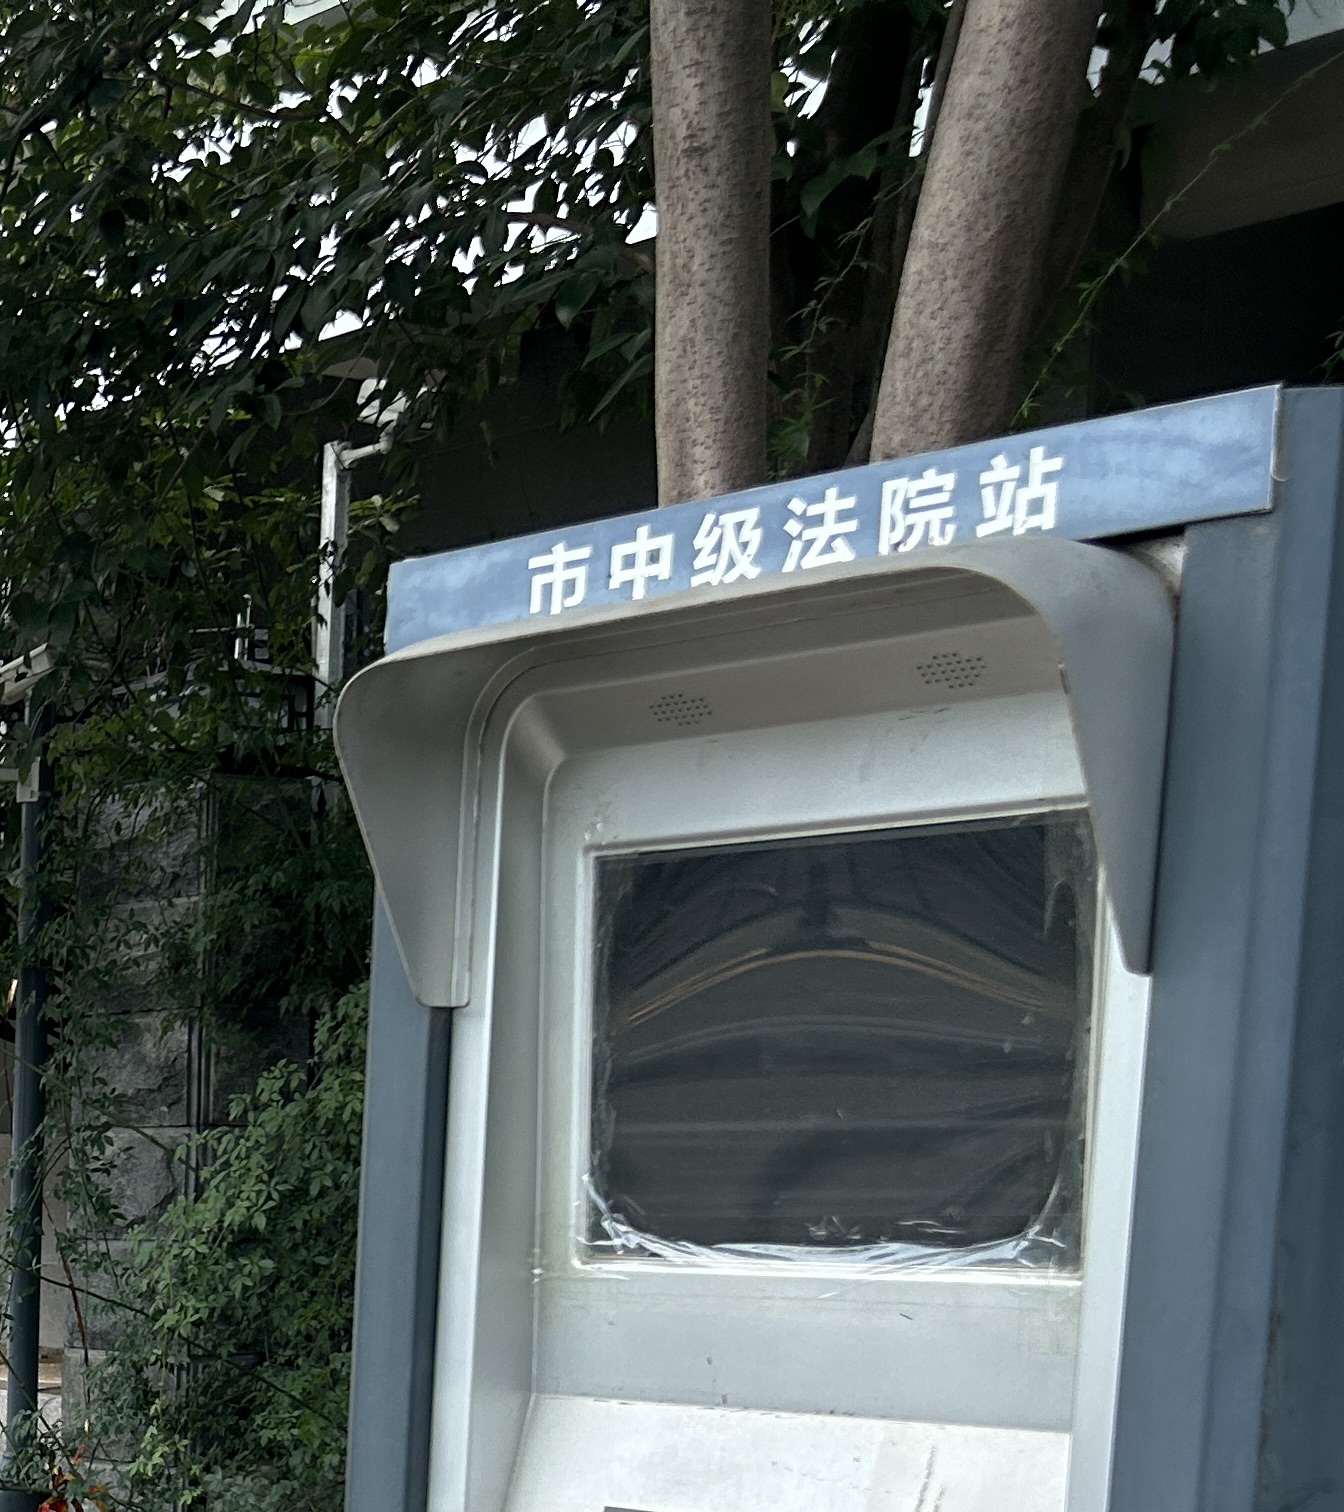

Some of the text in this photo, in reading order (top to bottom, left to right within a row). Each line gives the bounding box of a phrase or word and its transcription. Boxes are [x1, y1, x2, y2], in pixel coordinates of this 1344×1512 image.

[526, 445, 1065, 616] 市中级法院站
